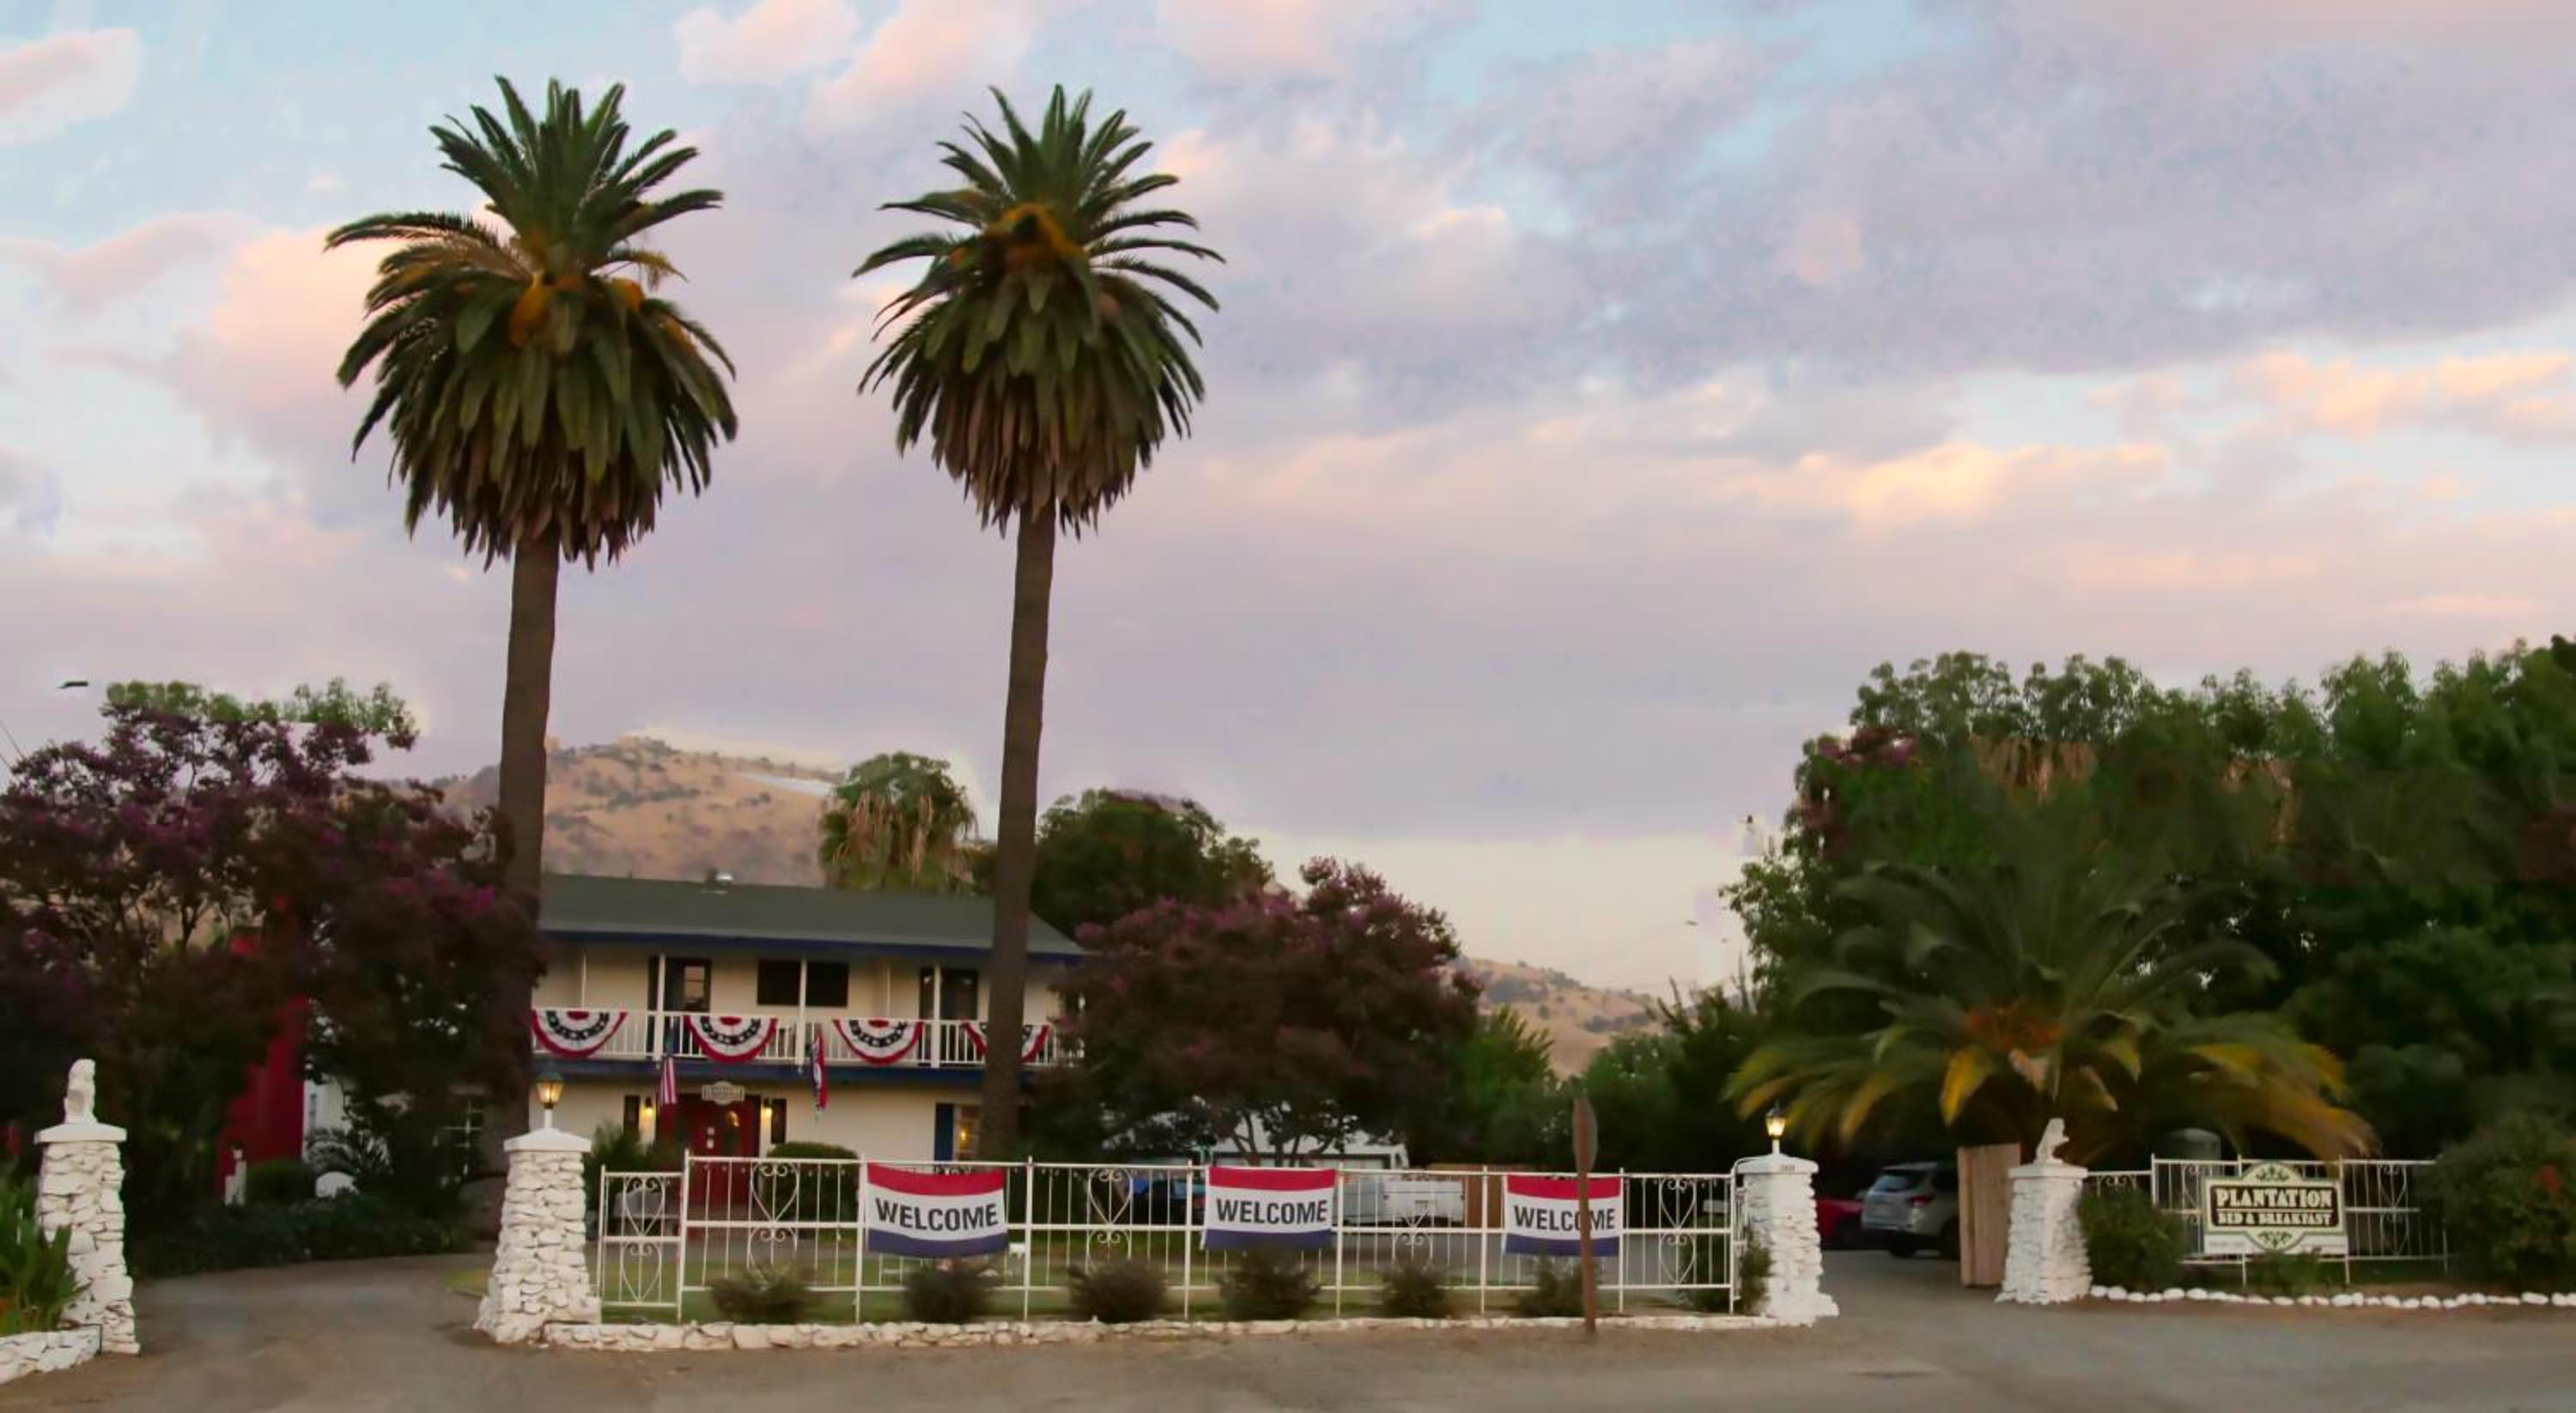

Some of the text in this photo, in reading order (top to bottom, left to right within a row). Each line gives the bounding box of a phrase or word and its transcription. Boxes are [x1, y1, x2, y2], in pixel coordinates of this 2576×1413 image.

[2215, 1188, 2332, 1208] PLANTATION
[875, 1198, 999, 1231] WELCOME
[1216, 1198, 1327, 1224] WELCOME
[2218, 1211, 2331, 1225] BED & BREAKFAST
